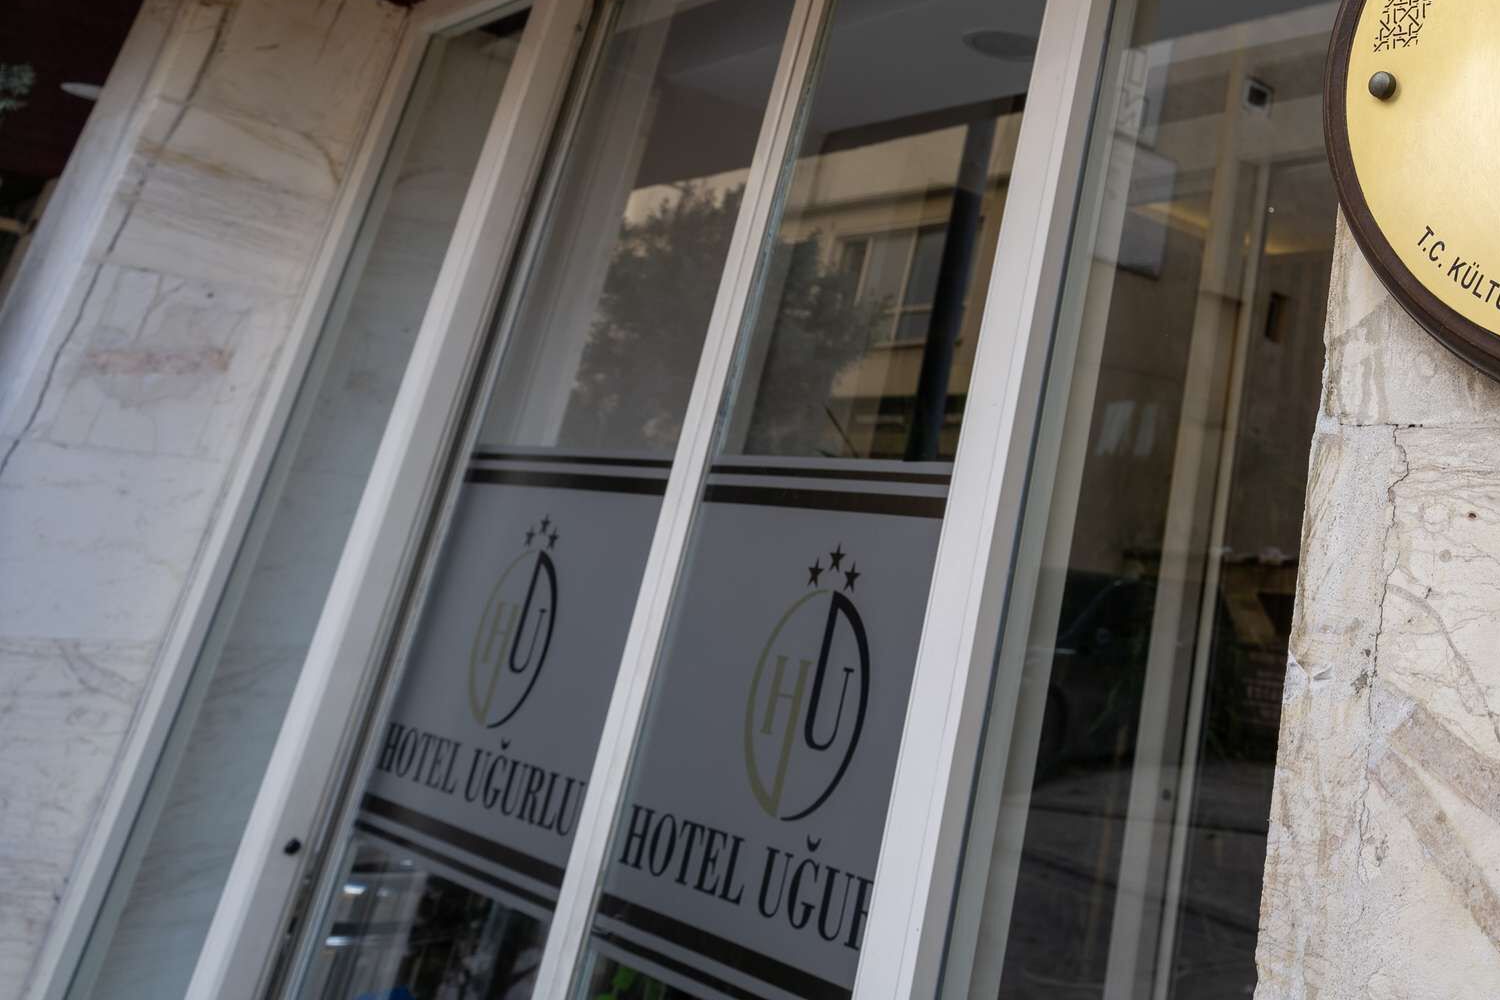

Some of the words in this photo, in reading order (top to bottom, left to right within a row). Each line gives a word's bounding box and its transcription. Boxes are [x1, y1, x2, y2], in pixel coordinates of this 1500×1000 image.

[1417, 225, 1446, 268] T.C.
[377, 721, 463, 795] HOTEL
[464, 738, 588, 836] UĞURLU
[618, 803, 745, 907] HOTEL
